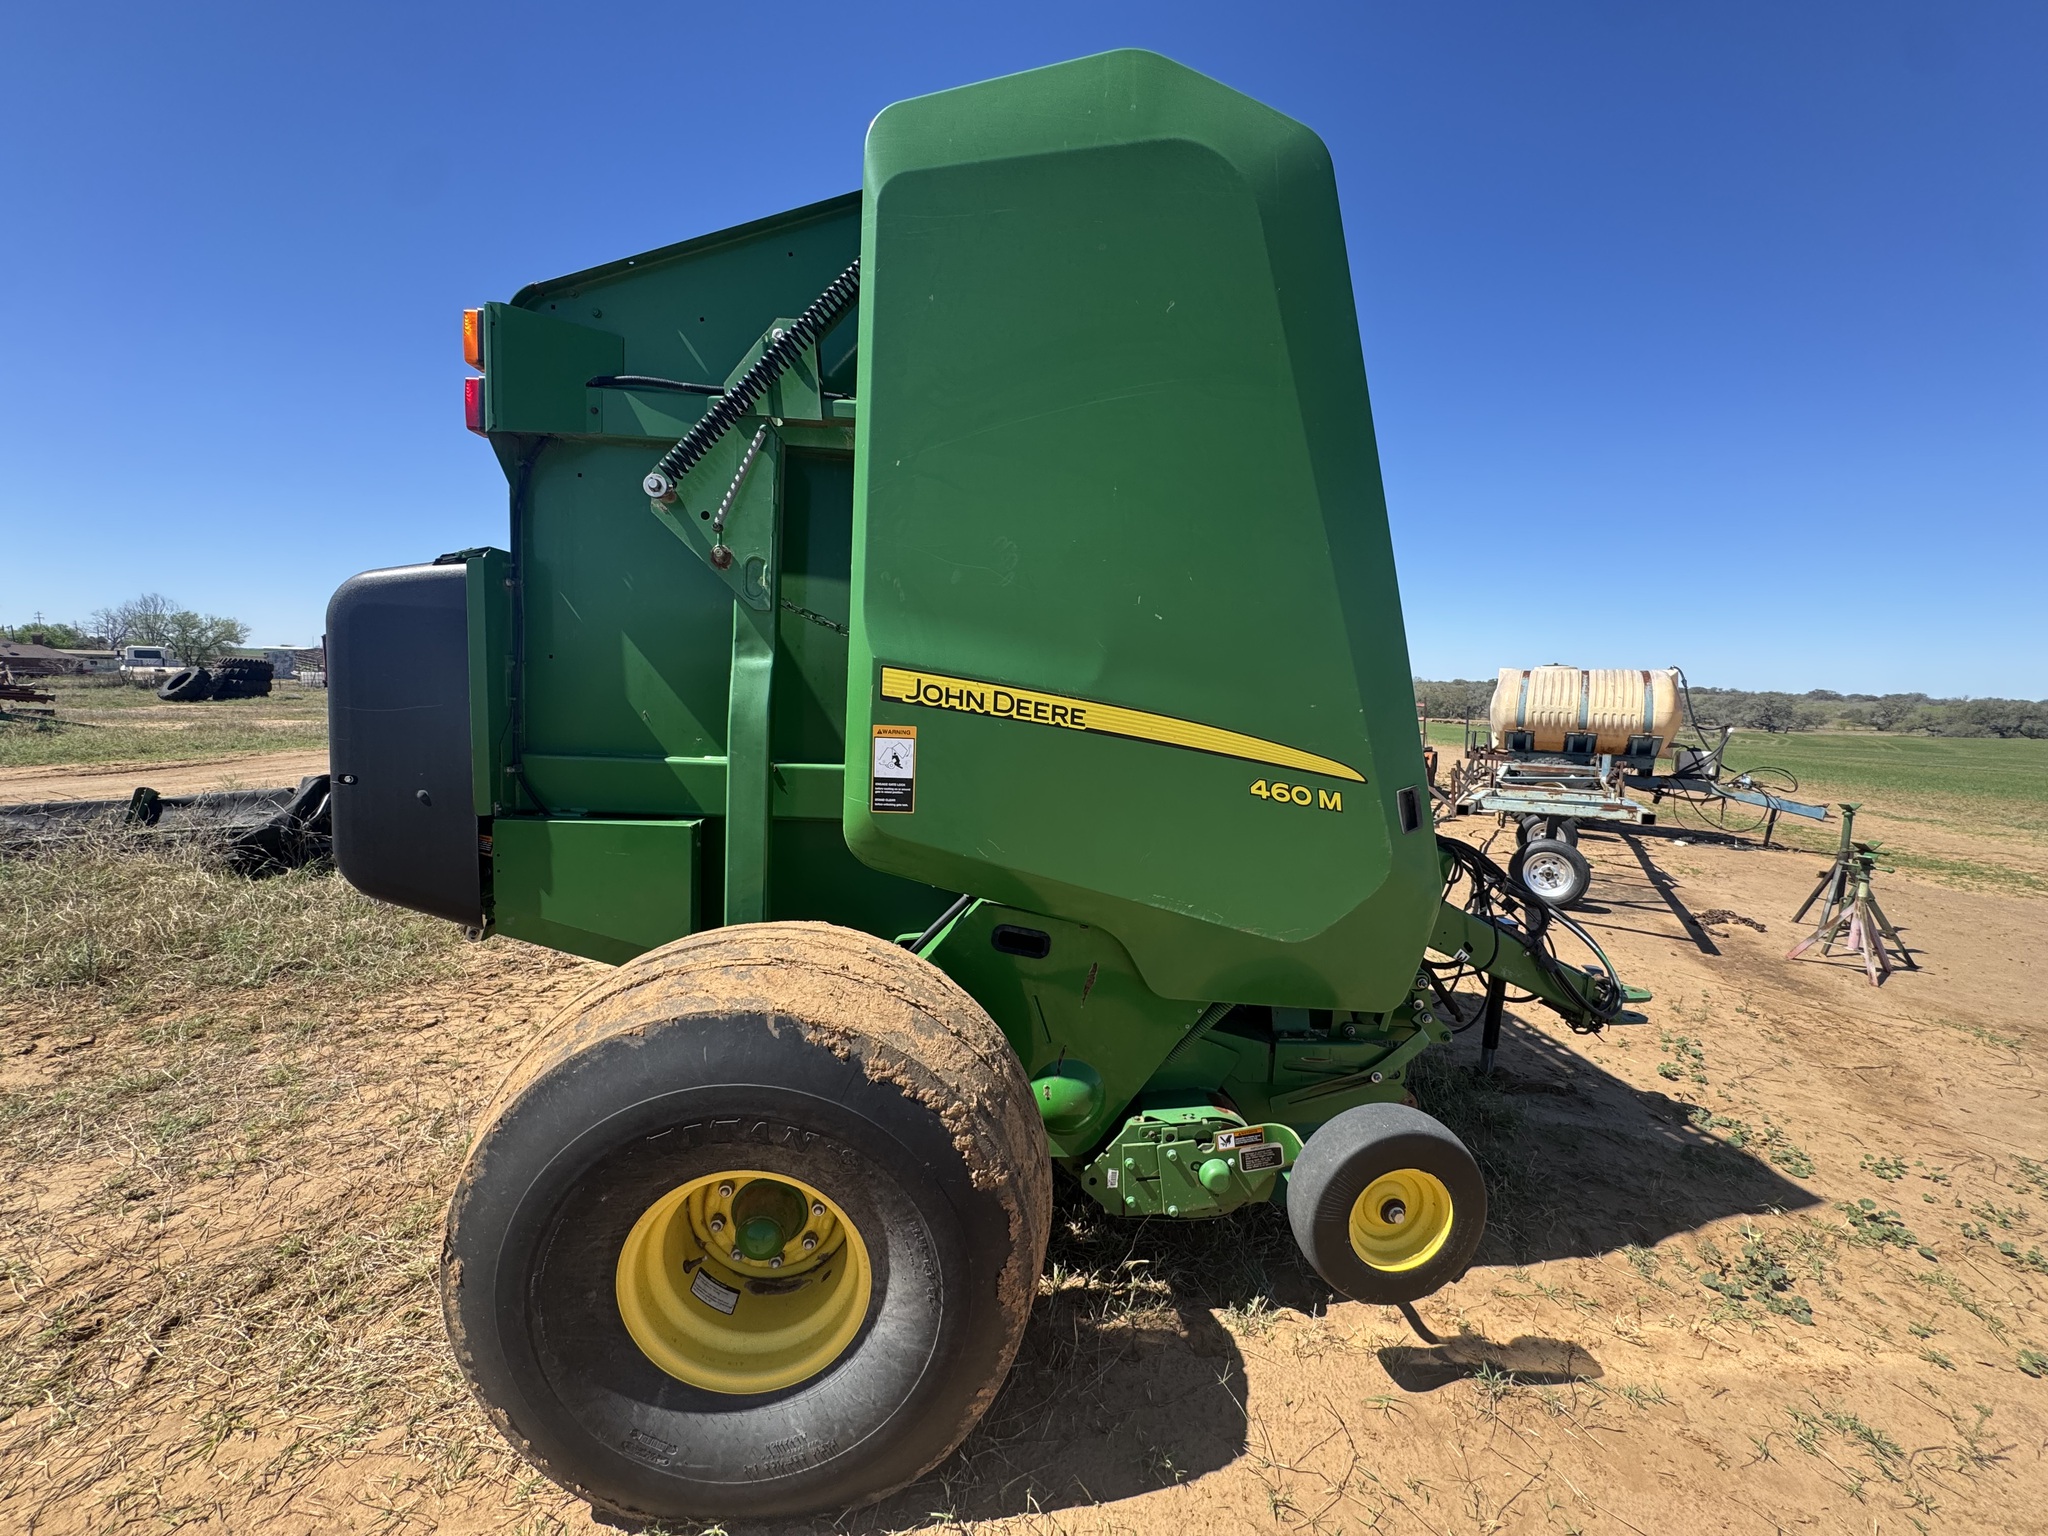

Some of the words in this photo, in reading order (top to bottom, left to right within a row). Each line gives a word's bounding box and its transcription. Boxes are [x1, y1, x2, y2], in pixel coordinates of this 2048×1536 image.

[905, 678, 985, 711] JOHN
[993, 690, 1087, 727] DEERE
[881, 728, 911, 736] WARNING
[1249, 778, 1313, 806] 460
[1318, 788, 1342, 812] M
